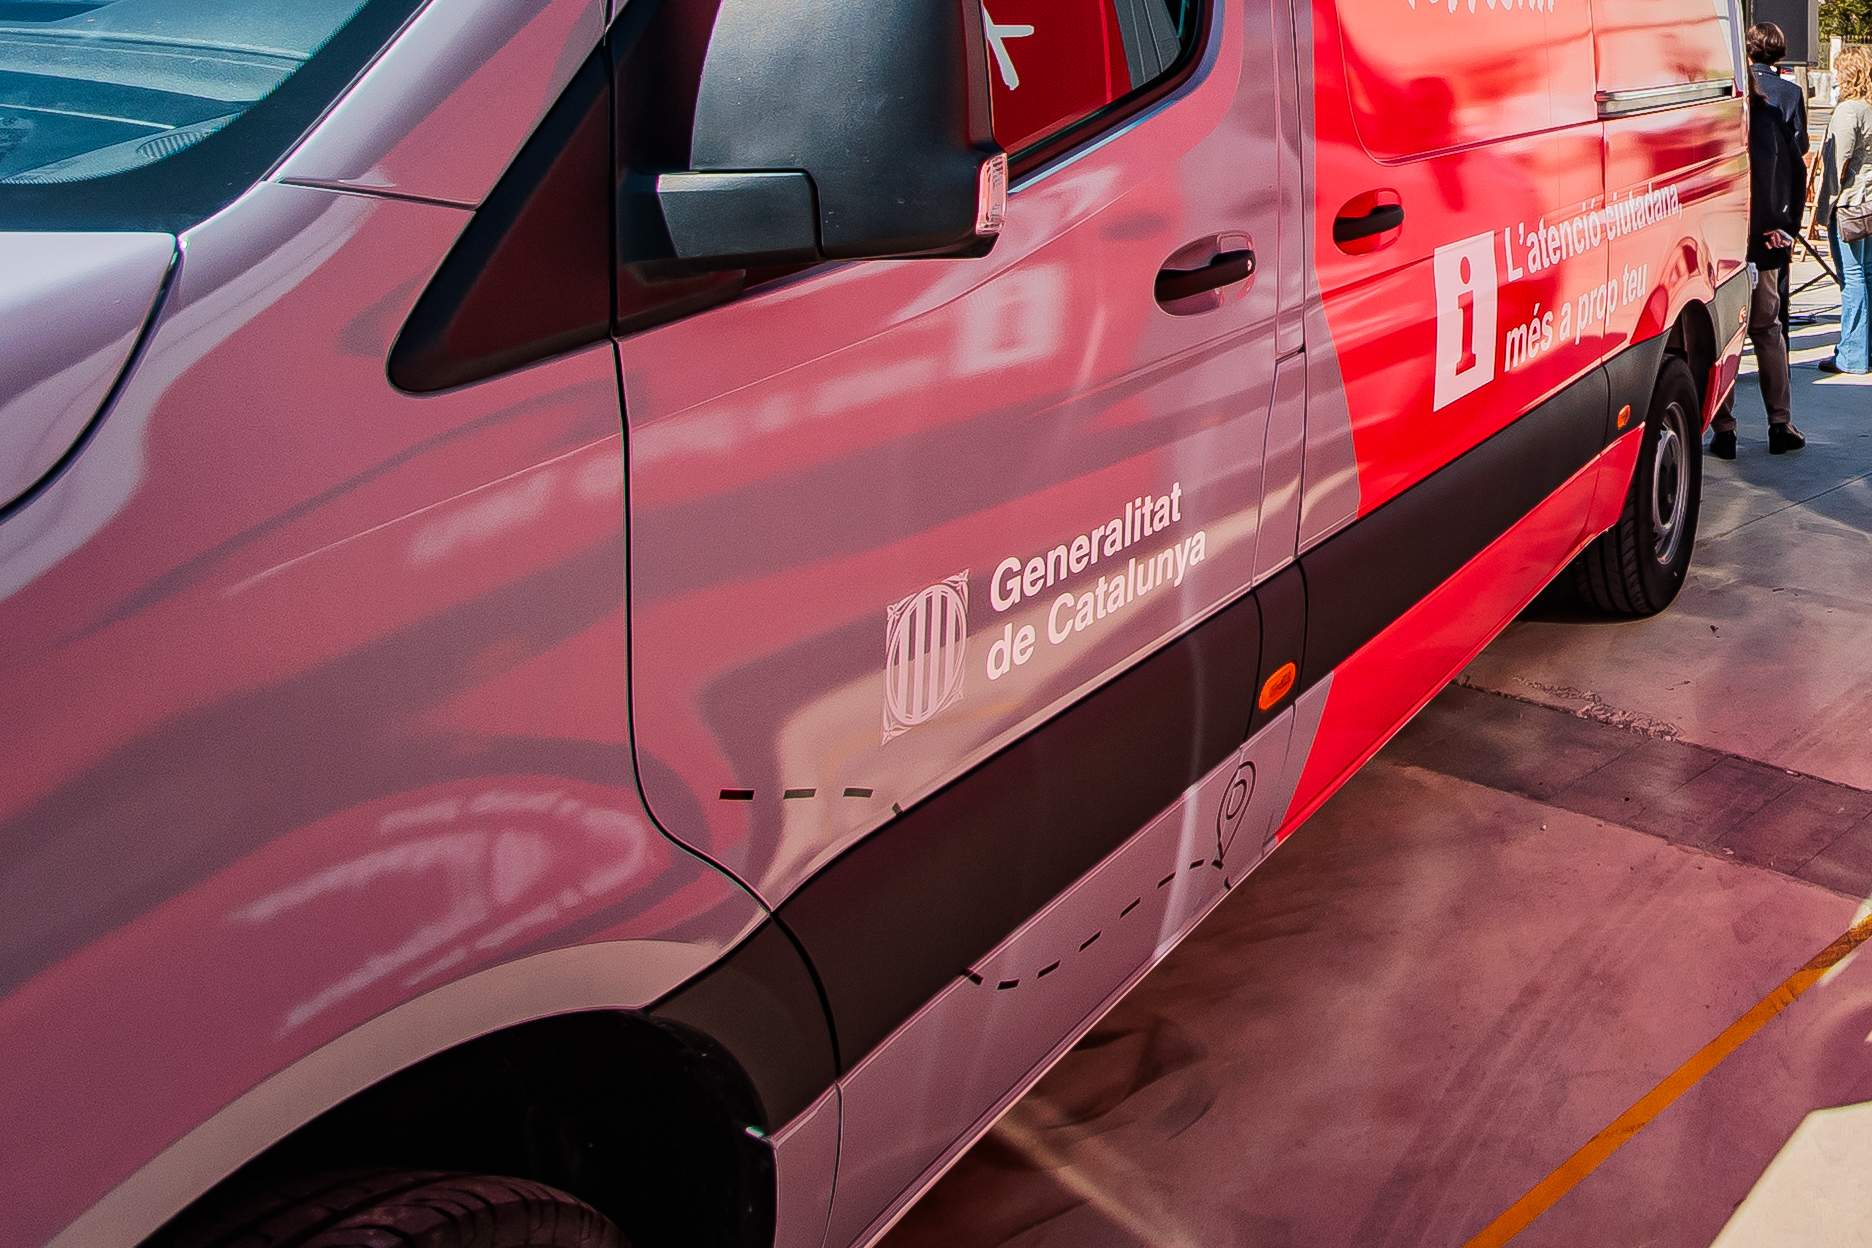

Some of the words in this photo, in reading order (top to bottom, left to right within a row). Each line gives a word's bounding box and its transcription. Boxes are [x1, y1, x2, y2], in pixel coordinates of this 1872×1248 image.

[1504, 197, 1601, 282] L'atenció
[1603, 181, 1683, 241] ciutadana,
[1504, 303, 1554, 373] més
[1559, 302, 1572, 340] a
[1575, 274, 1619, 346] prop
[1622, 263, 1649, 305] teu
[986, 623, 1036, 681] de
[1048, 530, 1207, 645] Catalunya
[990, 481, 1183, 612] Generalitat
